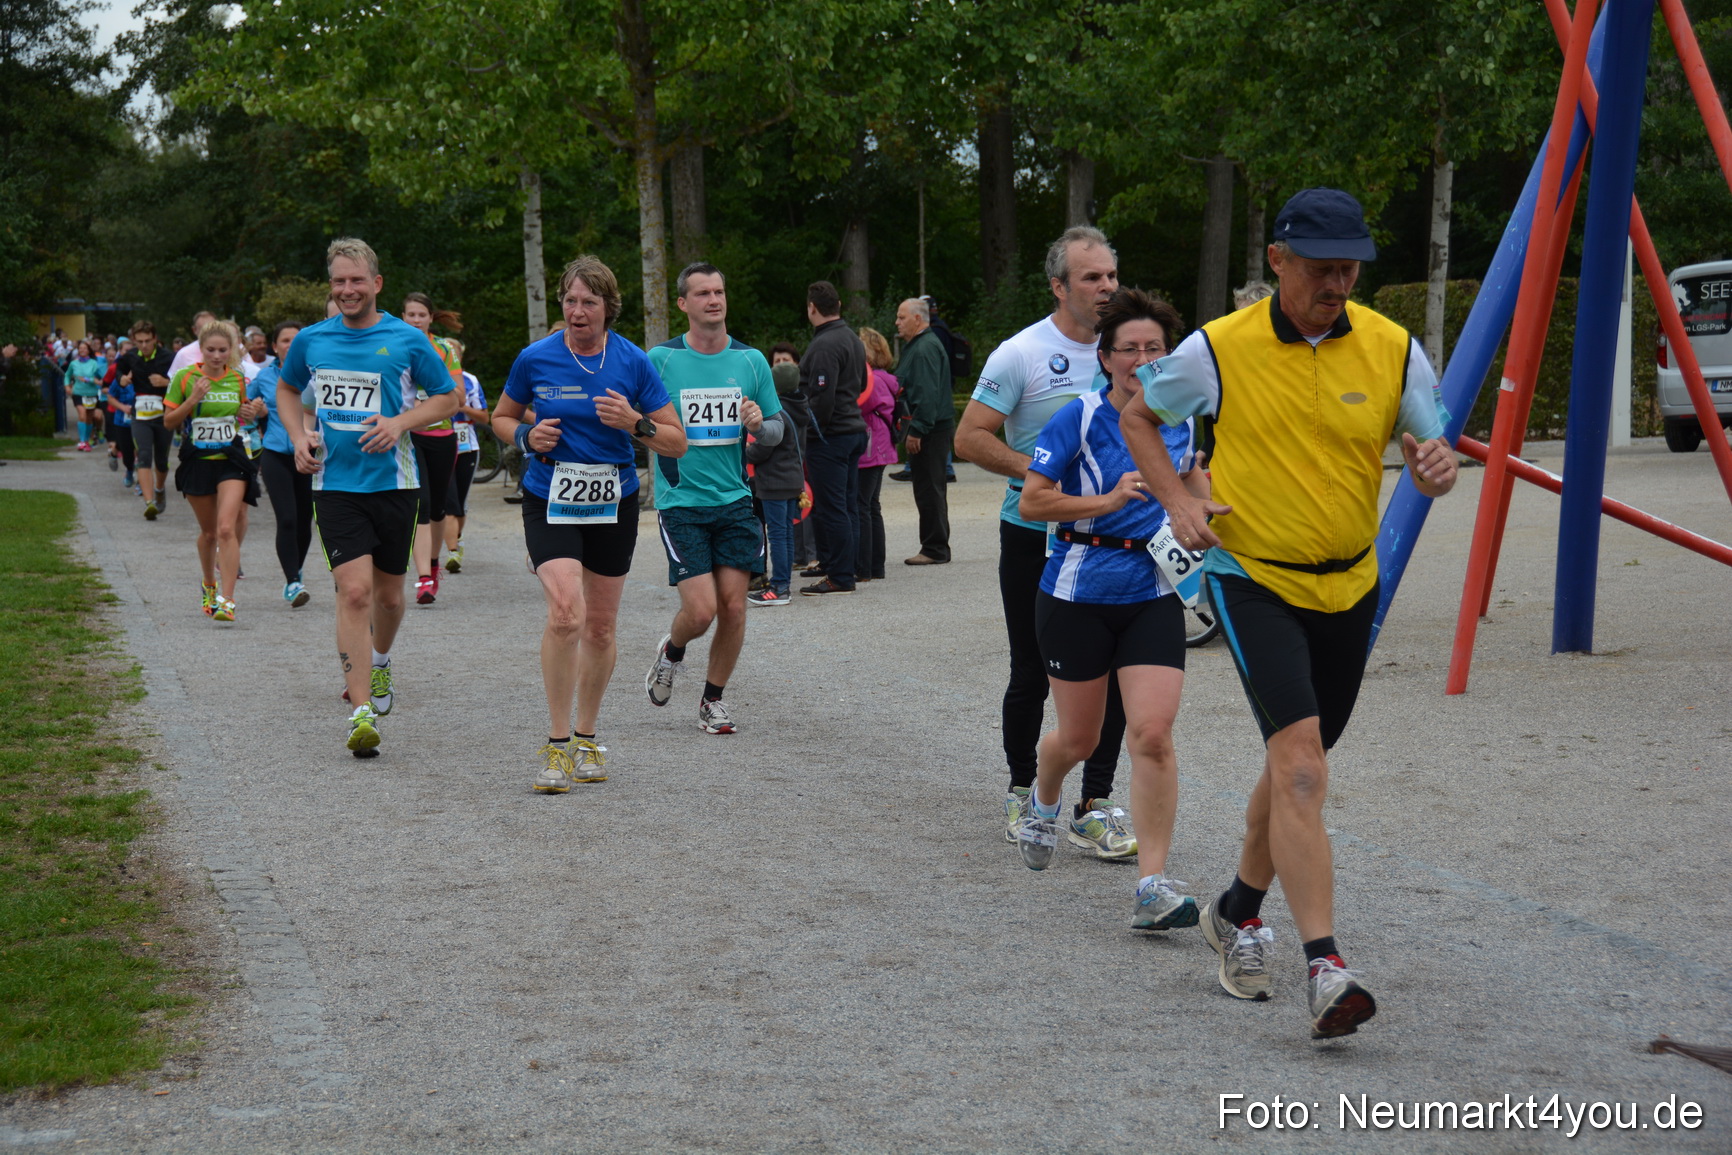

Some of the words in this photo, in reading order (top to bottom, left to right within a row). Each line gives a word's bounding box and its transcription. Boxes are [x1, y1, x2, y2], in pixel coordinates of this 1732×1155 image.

[1692, 323, 1726, 332] LGS-Park
[317, 374, 337, 382] PARTL
[337, 376, 370, 384] Neumarkt
[978, 376, 1000, 393] OCK
[1049, 377, 1073, 385] PARTL
[200, 391, 241, 404] OCK
[322, 384, 375, 408] 2577
[144, 401, 154, 411] 17
[688, 402, 738, 424] 2414
[197, 424, 233, 441] 2710
[707, 428, 721, 438] Kai
[556, 466, 578, 476] PARTL
[579, 469, 611, 478] Neumarkt
[557, 477, 616, 502] 2288
[560, 505, 605, 517] Hildegard
[1151, 534, 1175, 557] PARTL
